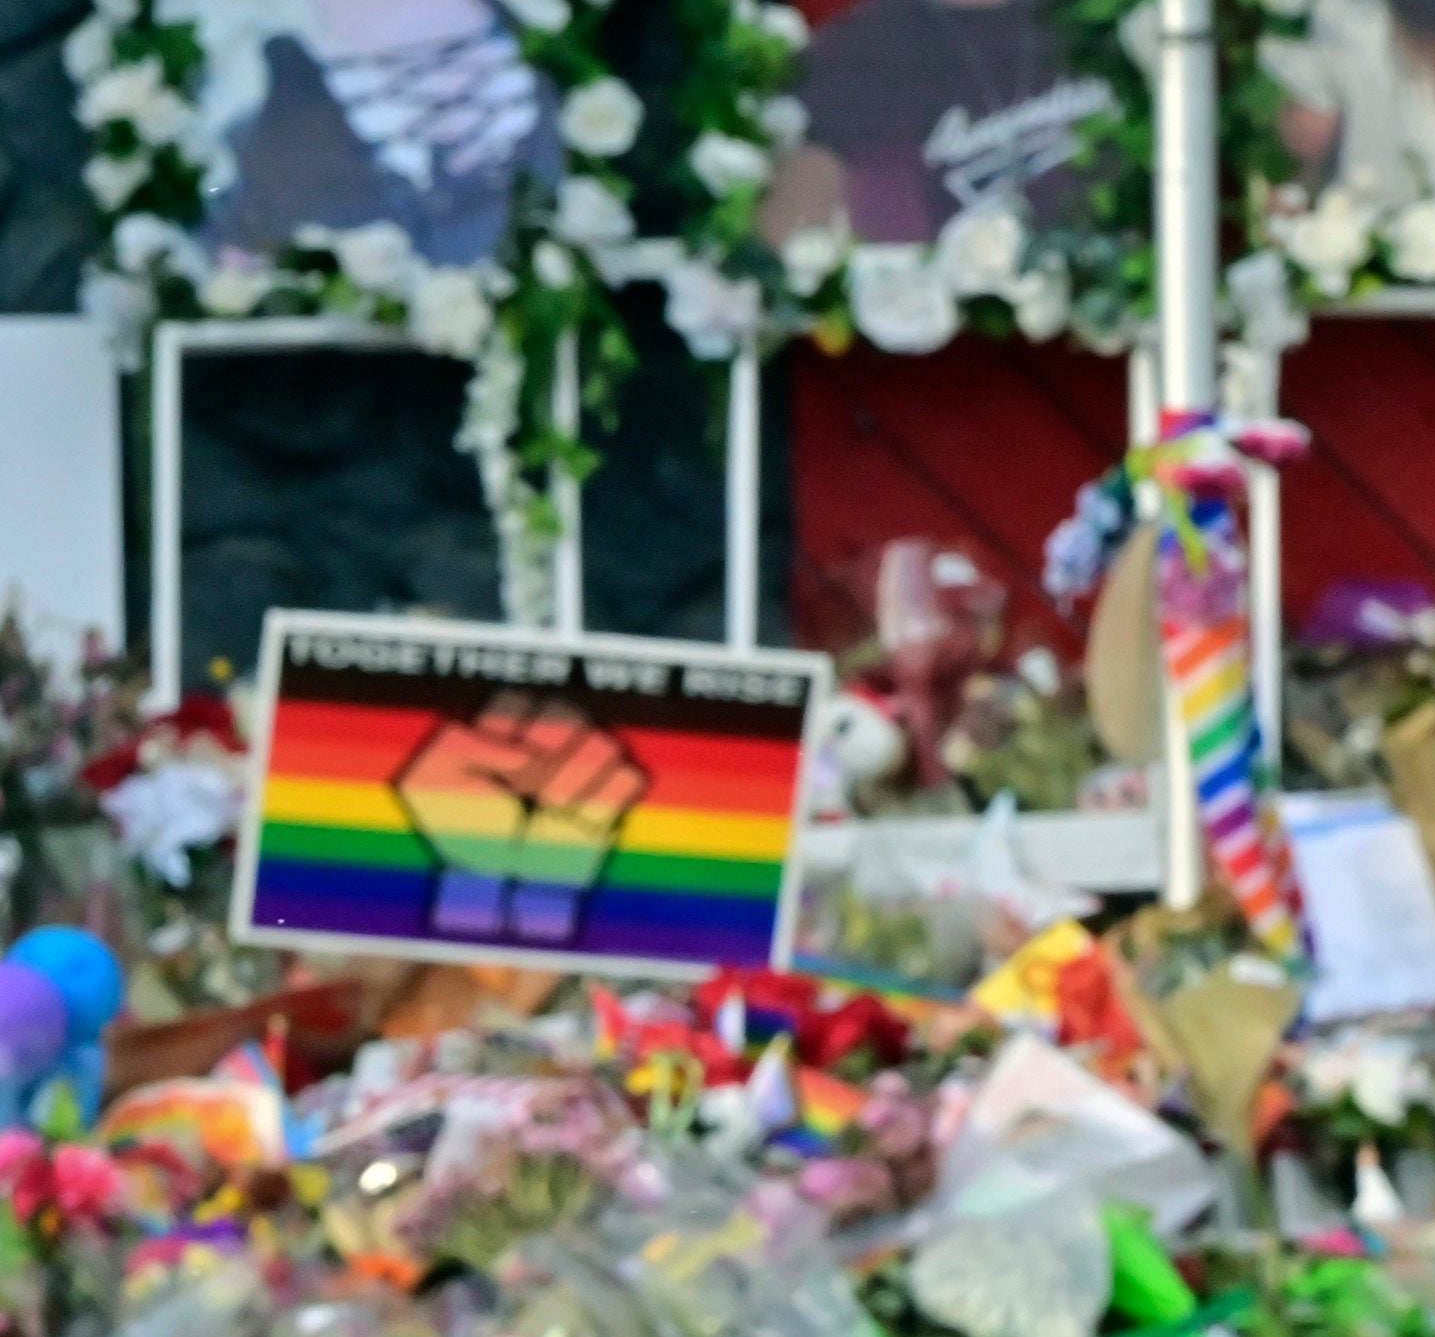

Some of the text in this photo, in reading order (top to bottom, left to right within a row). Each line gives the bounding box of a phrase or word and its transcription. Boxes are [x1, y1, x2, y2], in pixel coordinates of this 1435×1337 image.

[289, 633, 802, 707] TOGETHER WE RISE
